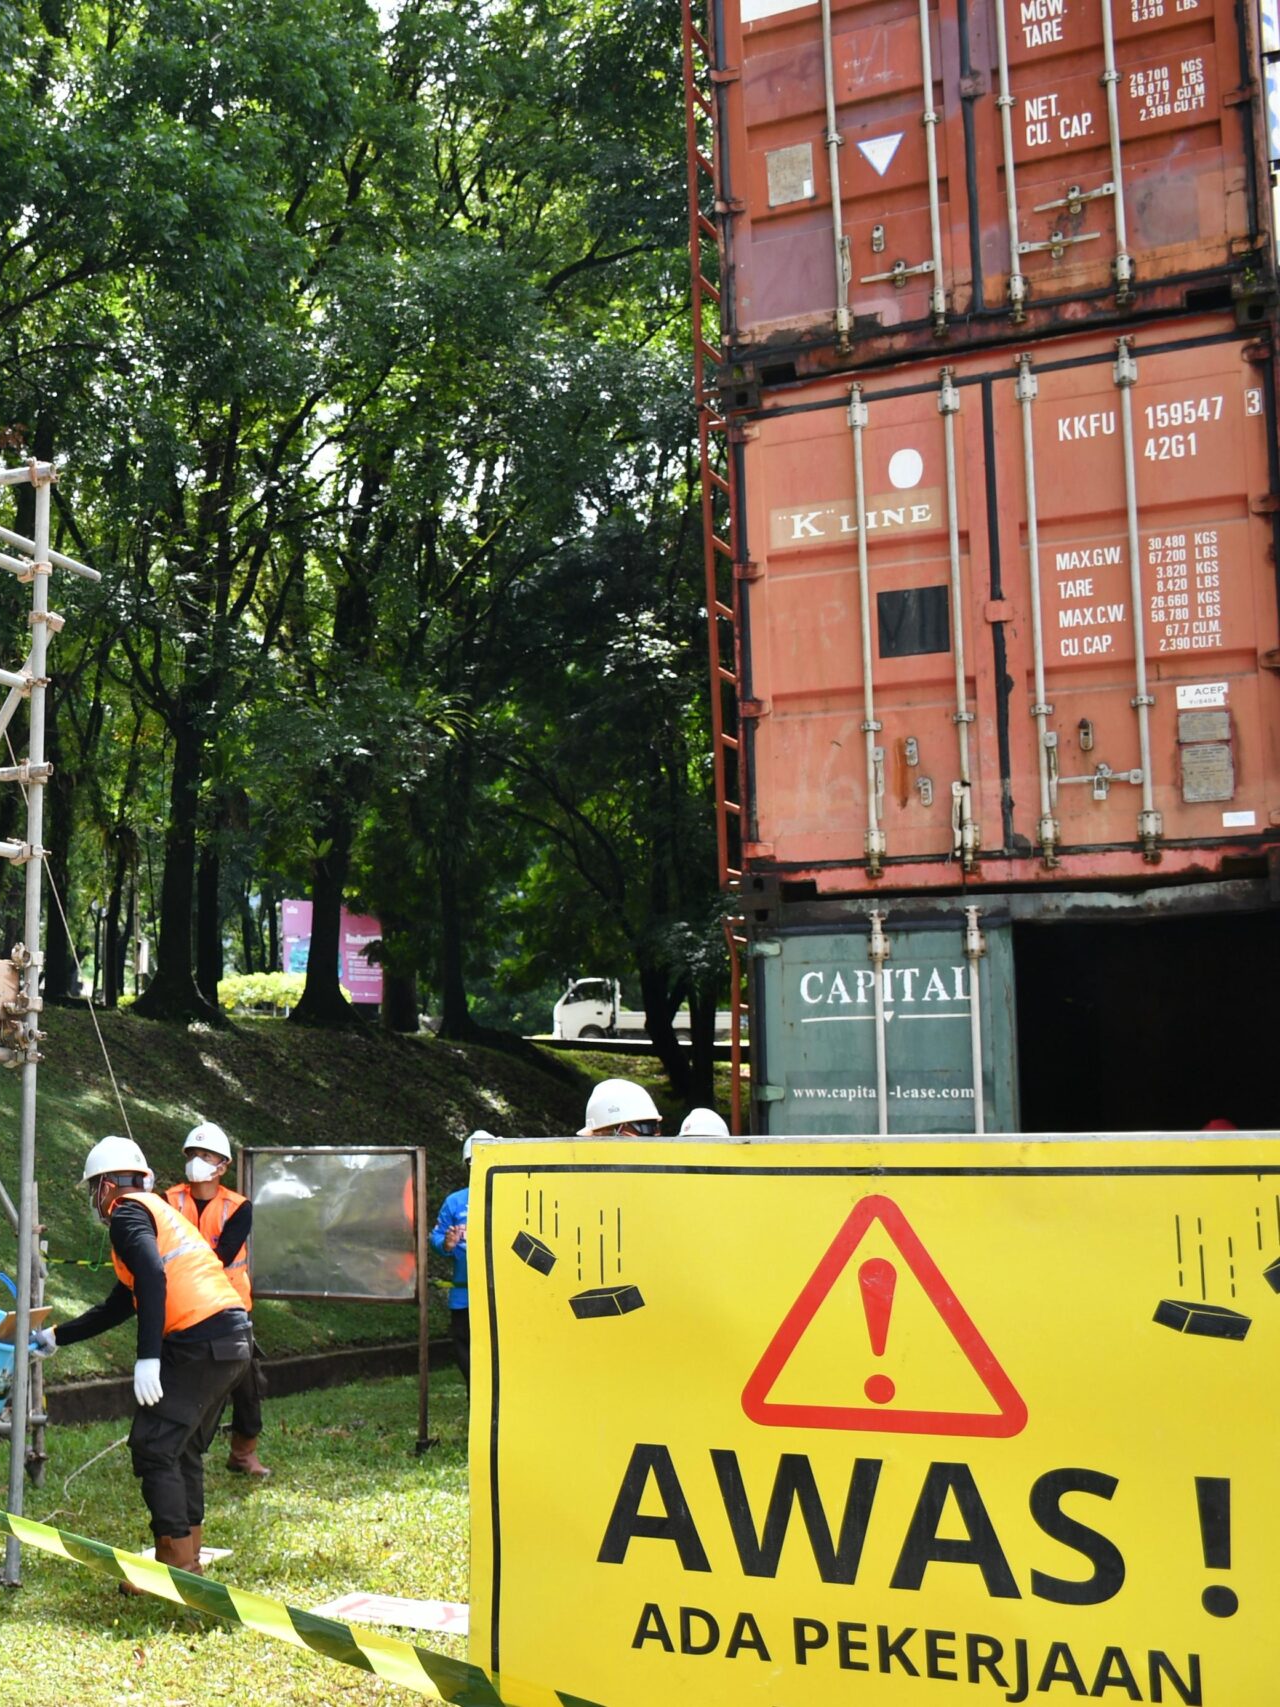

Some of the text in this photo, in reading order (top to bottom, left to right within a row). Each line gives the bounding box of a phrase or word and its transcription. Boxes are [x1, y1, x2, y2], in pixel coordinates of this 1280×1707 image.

[1020, 0, 1068, 24] MGW.
[1131, 0, 1198, 22] 8.330 LBS
[1022, 18, 1064, 48] TARE
[1129, 58, 1203, 86] 26.700 KGS
[1130, 72, 1204, 98] 58.870 LBS
[1025, 94, 1061, 122] NET.
[1146, 92, 1170, 107] 67.7
[1139, 104, 1171, 121] 2.388
[1026, 112, 1095, 146] CU. CAP.
[1057, 390, 1260, 441] KKFU 159547 3
[1144, 432, 1197, 461] 42G1
[840, 504, 932, 532] LINE
[1148, 531, 1218, 550] 30.480 KGS
[1148, 545, 1218, 564] 67.200 LBS
[1156, 560, 1219, 579] 3.820 KGS
[1057, 578, 1094, 599] TARE
[1156, 574, 1219, 593] 8.420 LBS
[1151, 590, 1220, 609] 26.660 KGS
[1151, 604, 1221, 623] 58.780 LBS
[1165, 622, 1189, 637] 67.7
[1159, 637, 1190, 651] 2.390
[1194, 685, 1225, 696] ACEP
[800, 966, 971, 1004] CAPITAL
[793, 1084, 975, 1101] www.capita-lease.com
[597, 1443, 1240, 1618] AWAS !
[631, 1603, 1203, 1706] ADA PEKERJAAN
